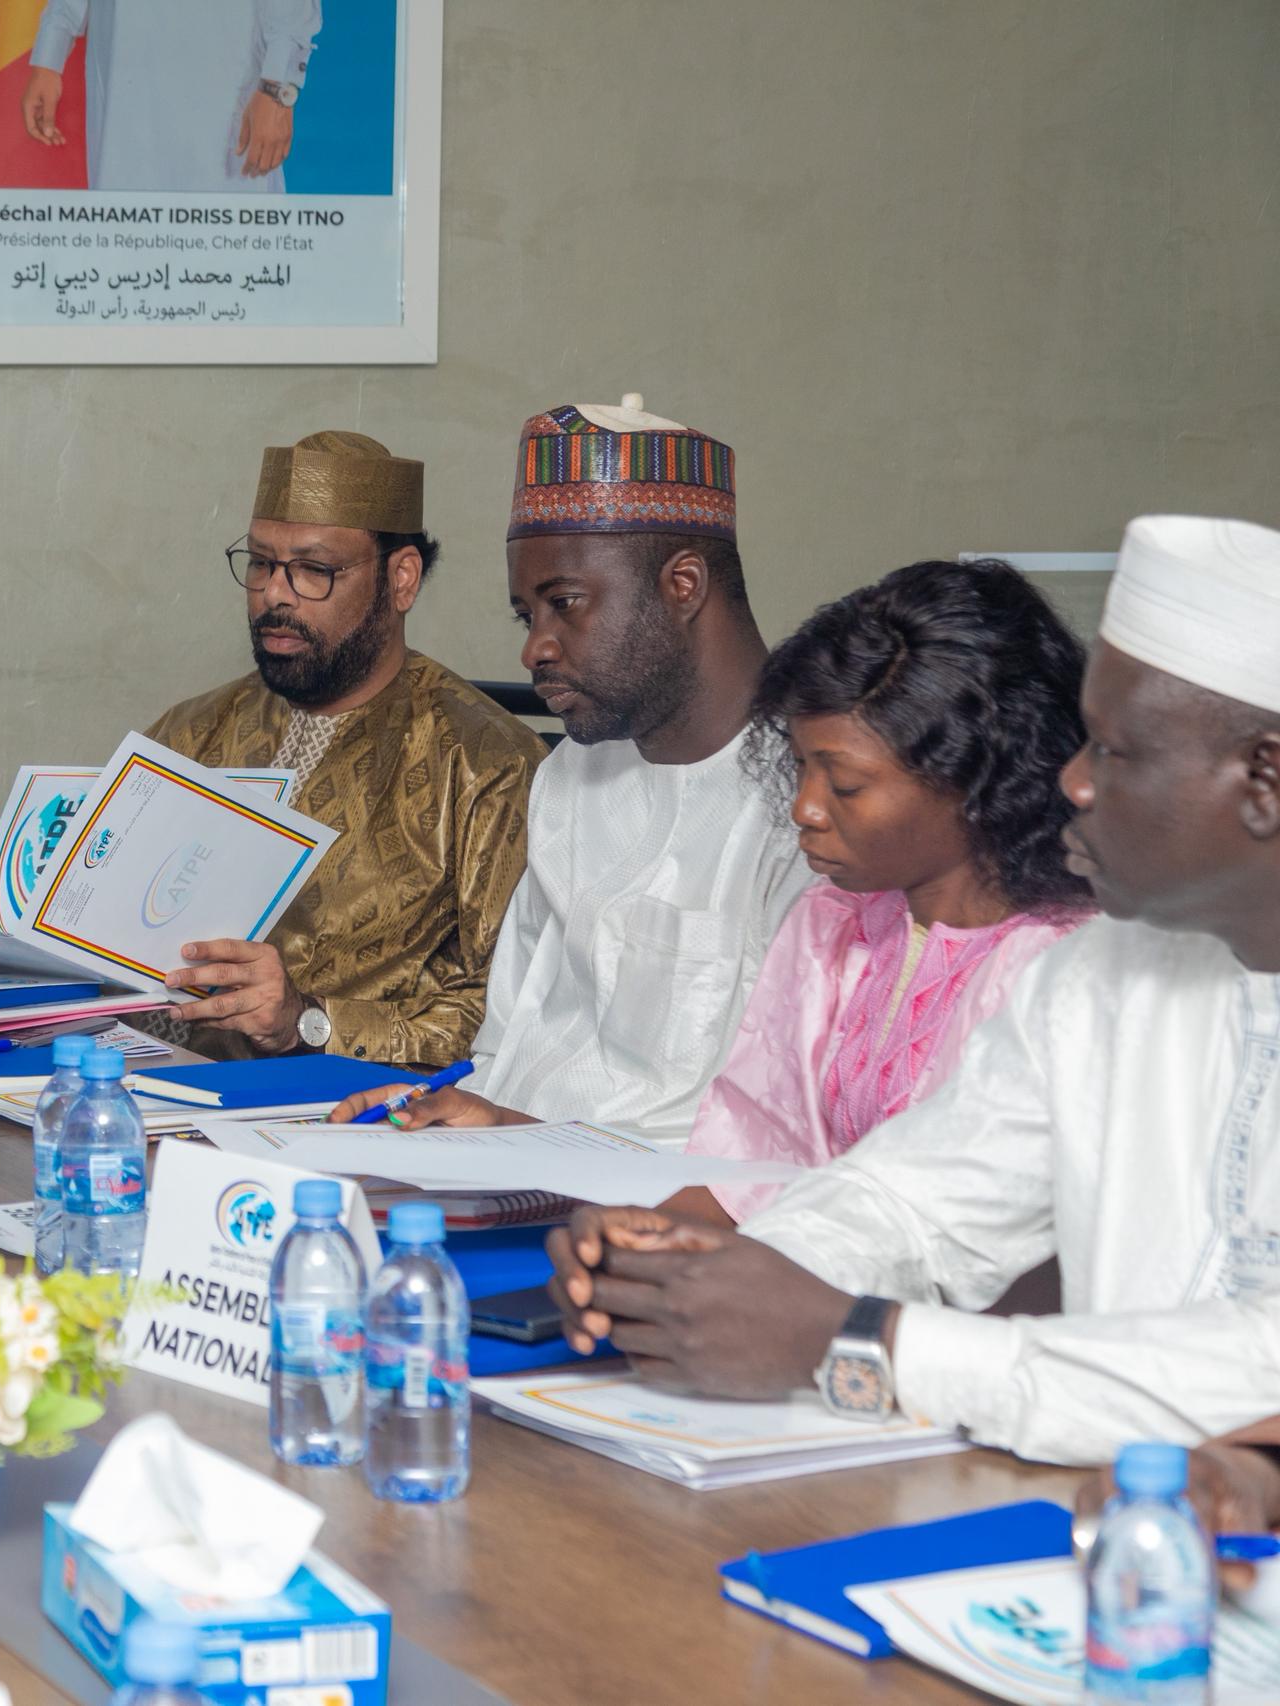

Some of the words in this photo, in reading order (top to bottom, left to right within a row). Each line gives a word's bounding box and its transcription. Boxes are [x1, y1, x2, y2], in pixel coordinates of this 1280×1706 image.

[58, 206, 163, 224] MAHAMAT
[169, 207, 233, 225] IDRISS
[239, 209, 292, 226] DEBY
[297, 210, 345, 227] ITNO
[71, 233, 92, 248] de
[96, 233, 109, 248] la
[113, 234, 208, 251] République,
[211, 235, 249, 250] Chef
[252, 236, 271, 250] de
[275, 235, 314, 251] l'État
[11, 261, 47, 289] إتنو
[54, 267, 100, 295] ديبي
[107, 263, 170, 290] إدريس
[178, 267, 233, 285] محمد
[239, 263, 291, 292] المشير
[55, 299, 96, 319] الدولة
[100, 296, 128, 320] رأس
[210, 301, 246, 321] رئيس
[95, 830, 115, 857] ATPE
[167, 842, 214, 903] ATPE
[161, 1269, 271, 1329] ASSEMBL
[142, 1320, 271, 1387] NATIONAL
